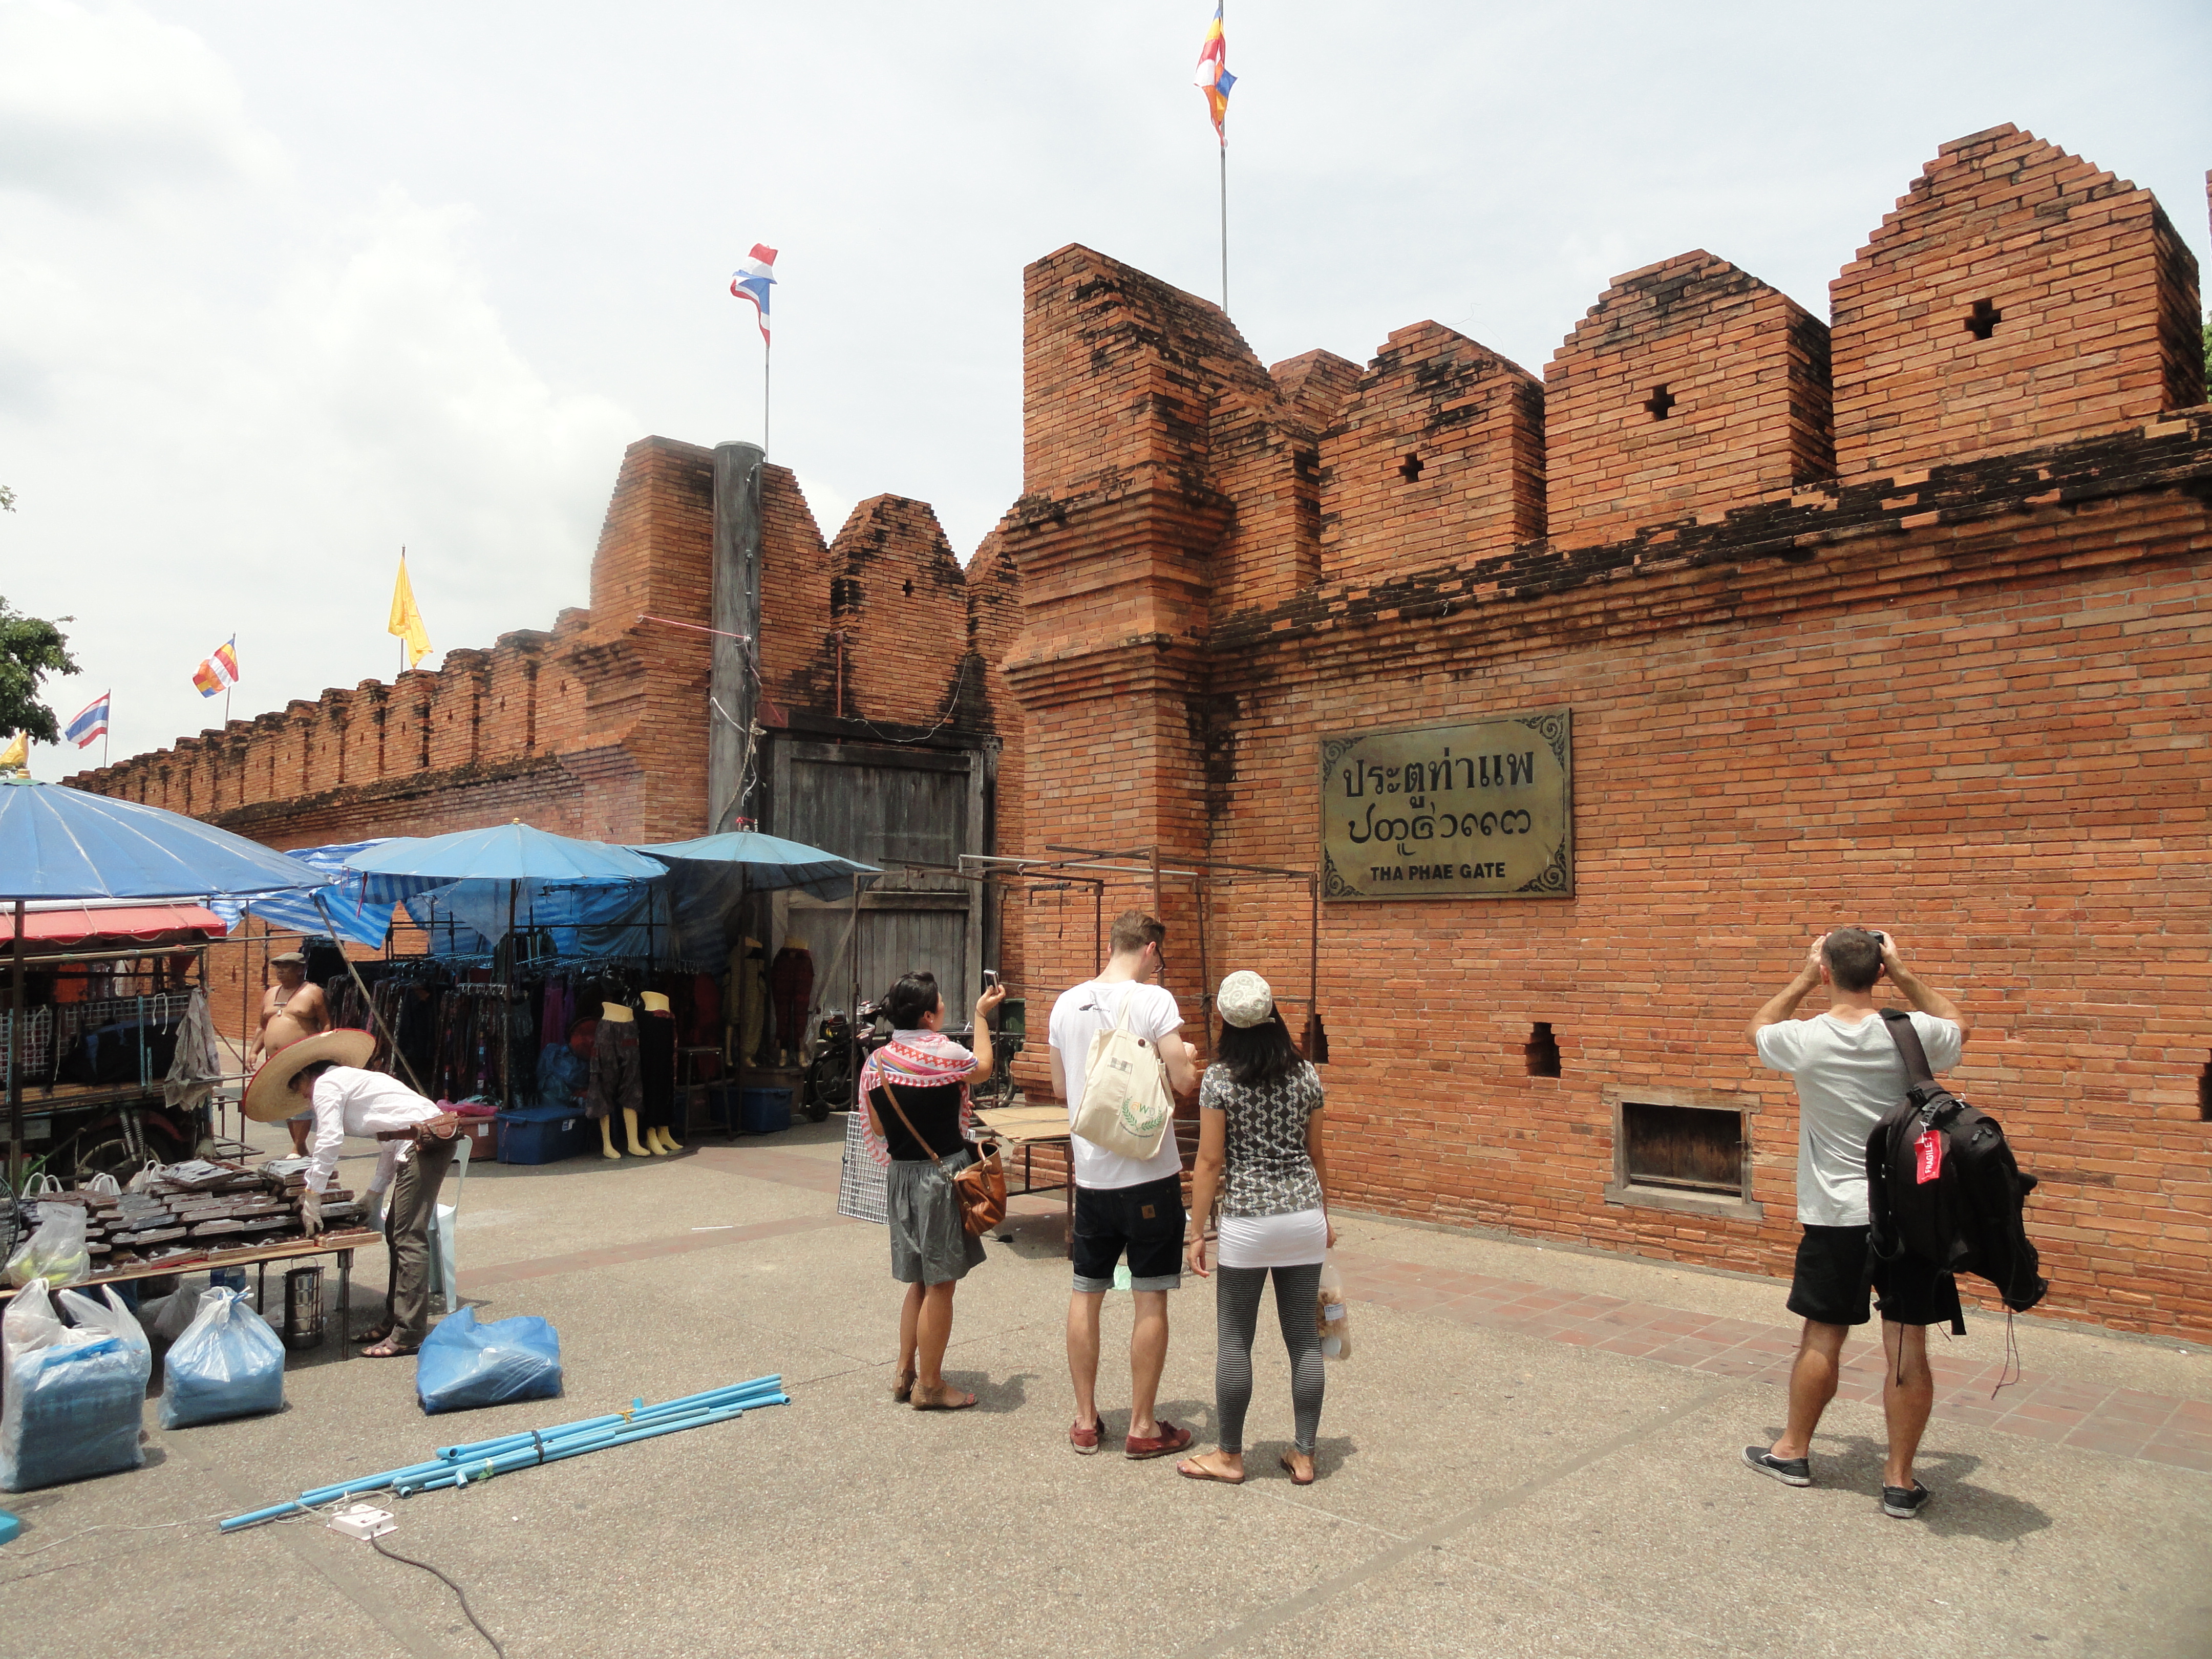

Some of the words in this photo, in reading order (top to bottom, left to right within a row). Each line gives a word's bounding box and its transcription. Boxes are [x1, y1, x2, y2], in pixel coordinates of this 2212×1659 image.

[1343, 747, 1534, 809] ประตูท่าแพ
[1370, 866, 1403, 881] THA
[1409, 864, 1454, 880] PHAE
[1459, 862, 1505, 879] GATE
[1924, 1141, 1934, 1174] FRAGILE
